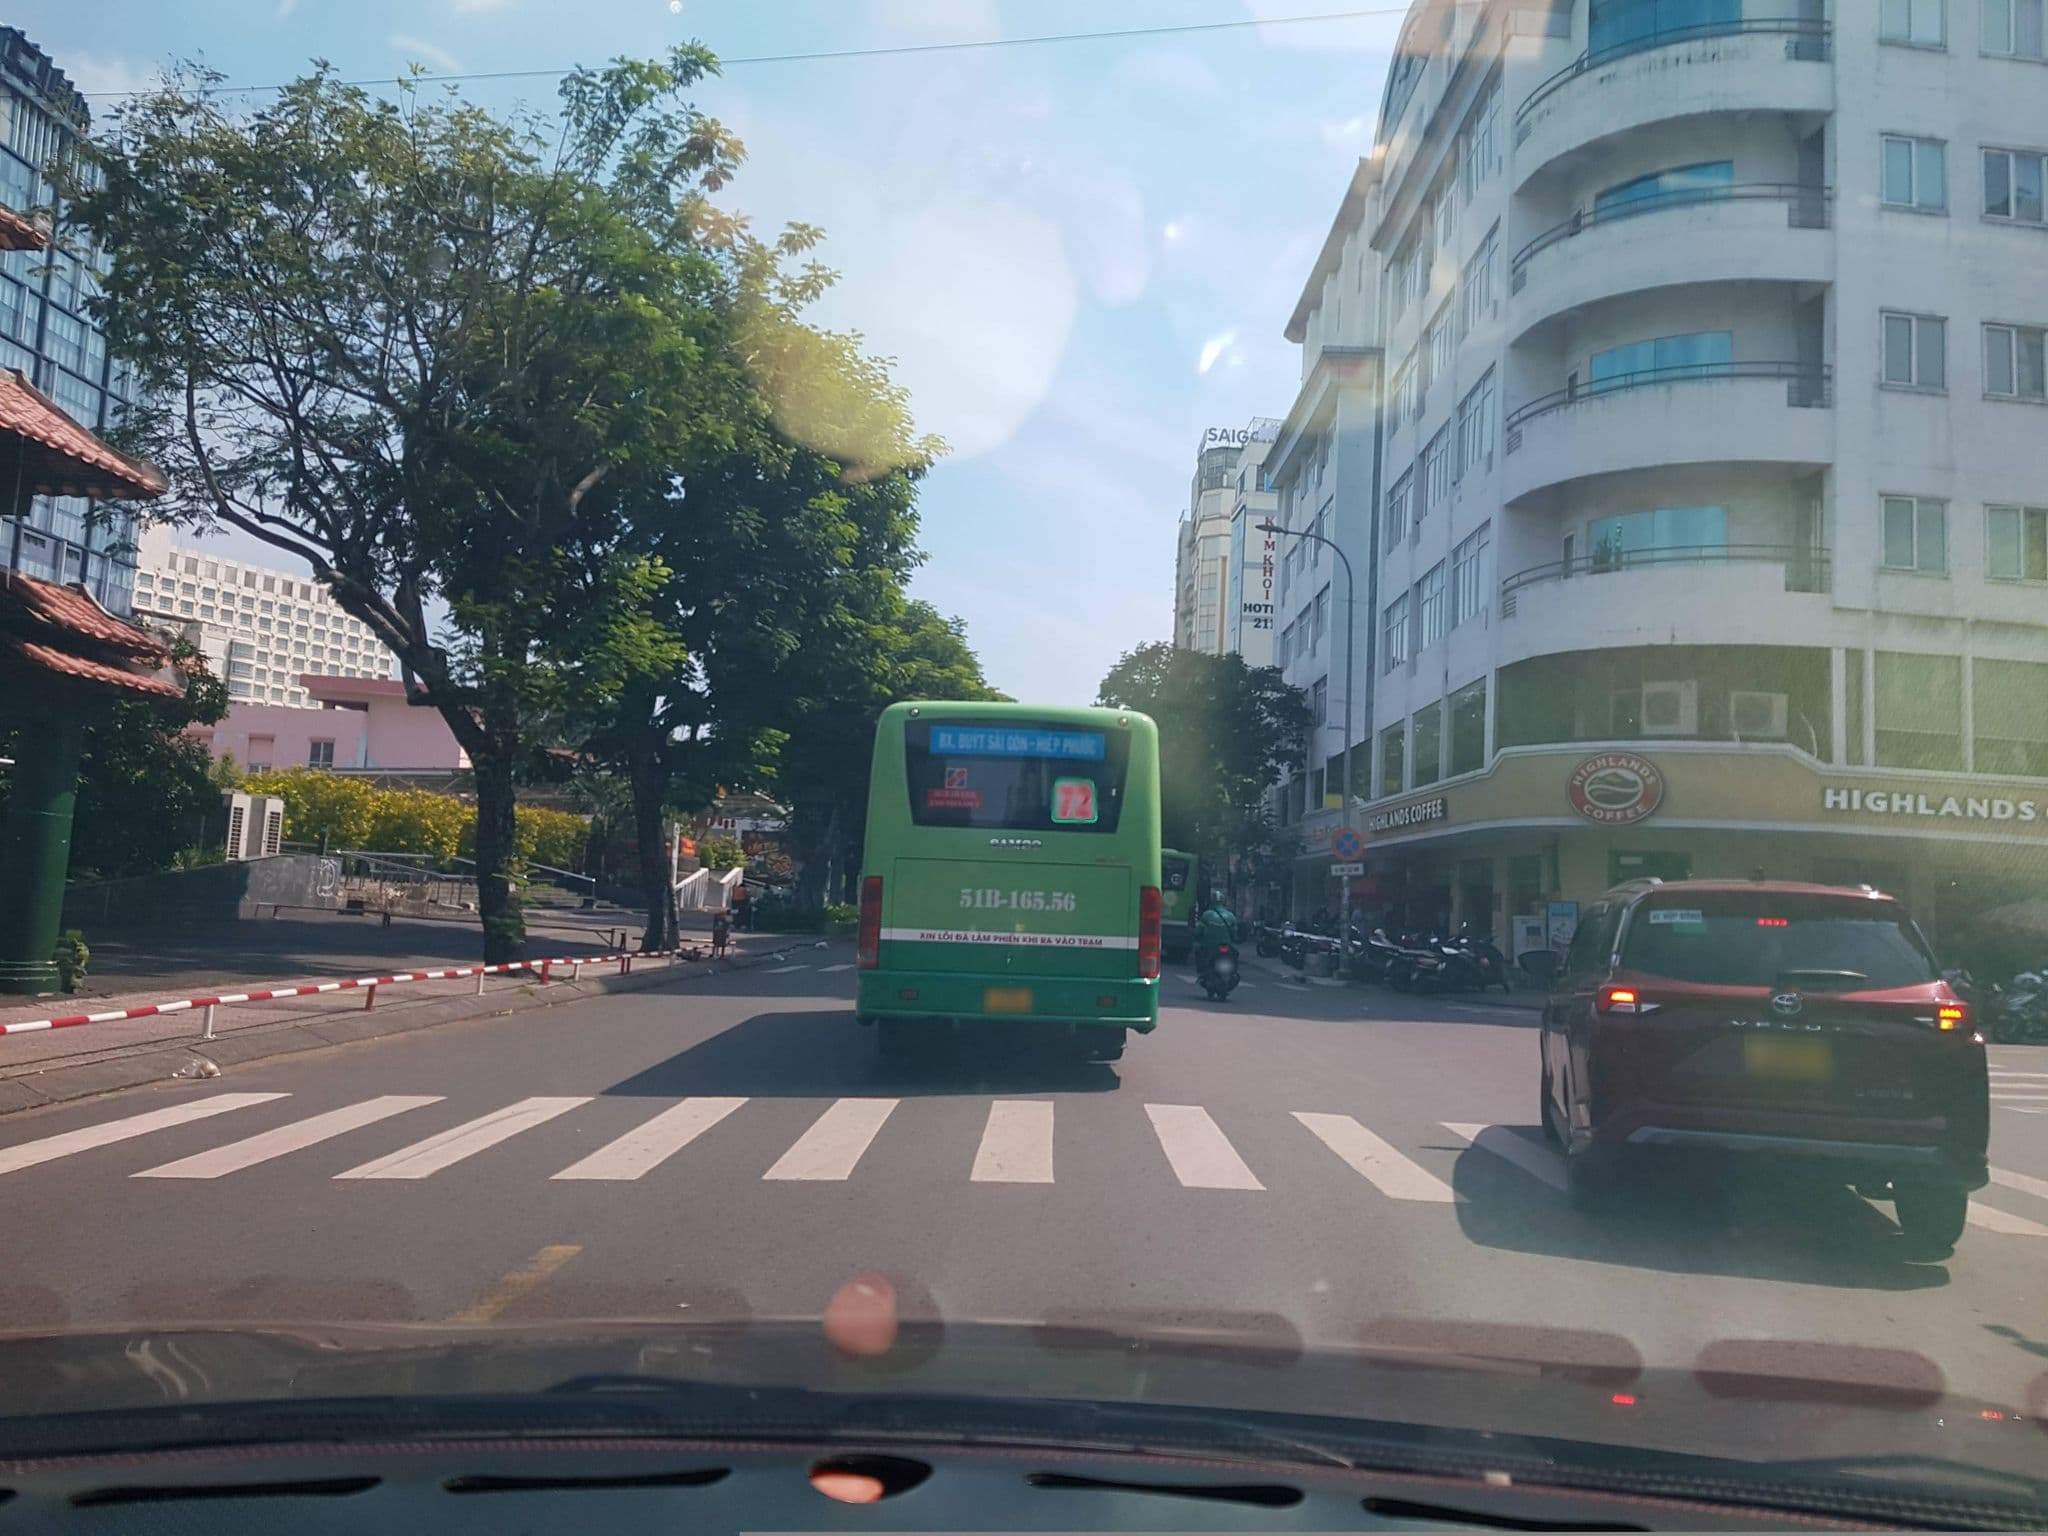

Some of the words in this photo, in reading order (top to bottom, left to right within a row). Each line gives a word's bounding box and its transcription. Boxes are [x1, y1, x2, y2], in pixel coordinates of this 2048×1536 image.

[1572, 756, 1657, 785] HIGHLANDS
[1059, 786, 1093, 819] 72
[1368, 808, 1410, 832] HIGHLANDS
[1411, 799, 1443, 823] COFFEE
[1583, 803, 1647, 820] COFFEE
[1824, 788, 2037, 821] HIGHLANDS
[959, 888, 1077, 913] 51B-165.56
